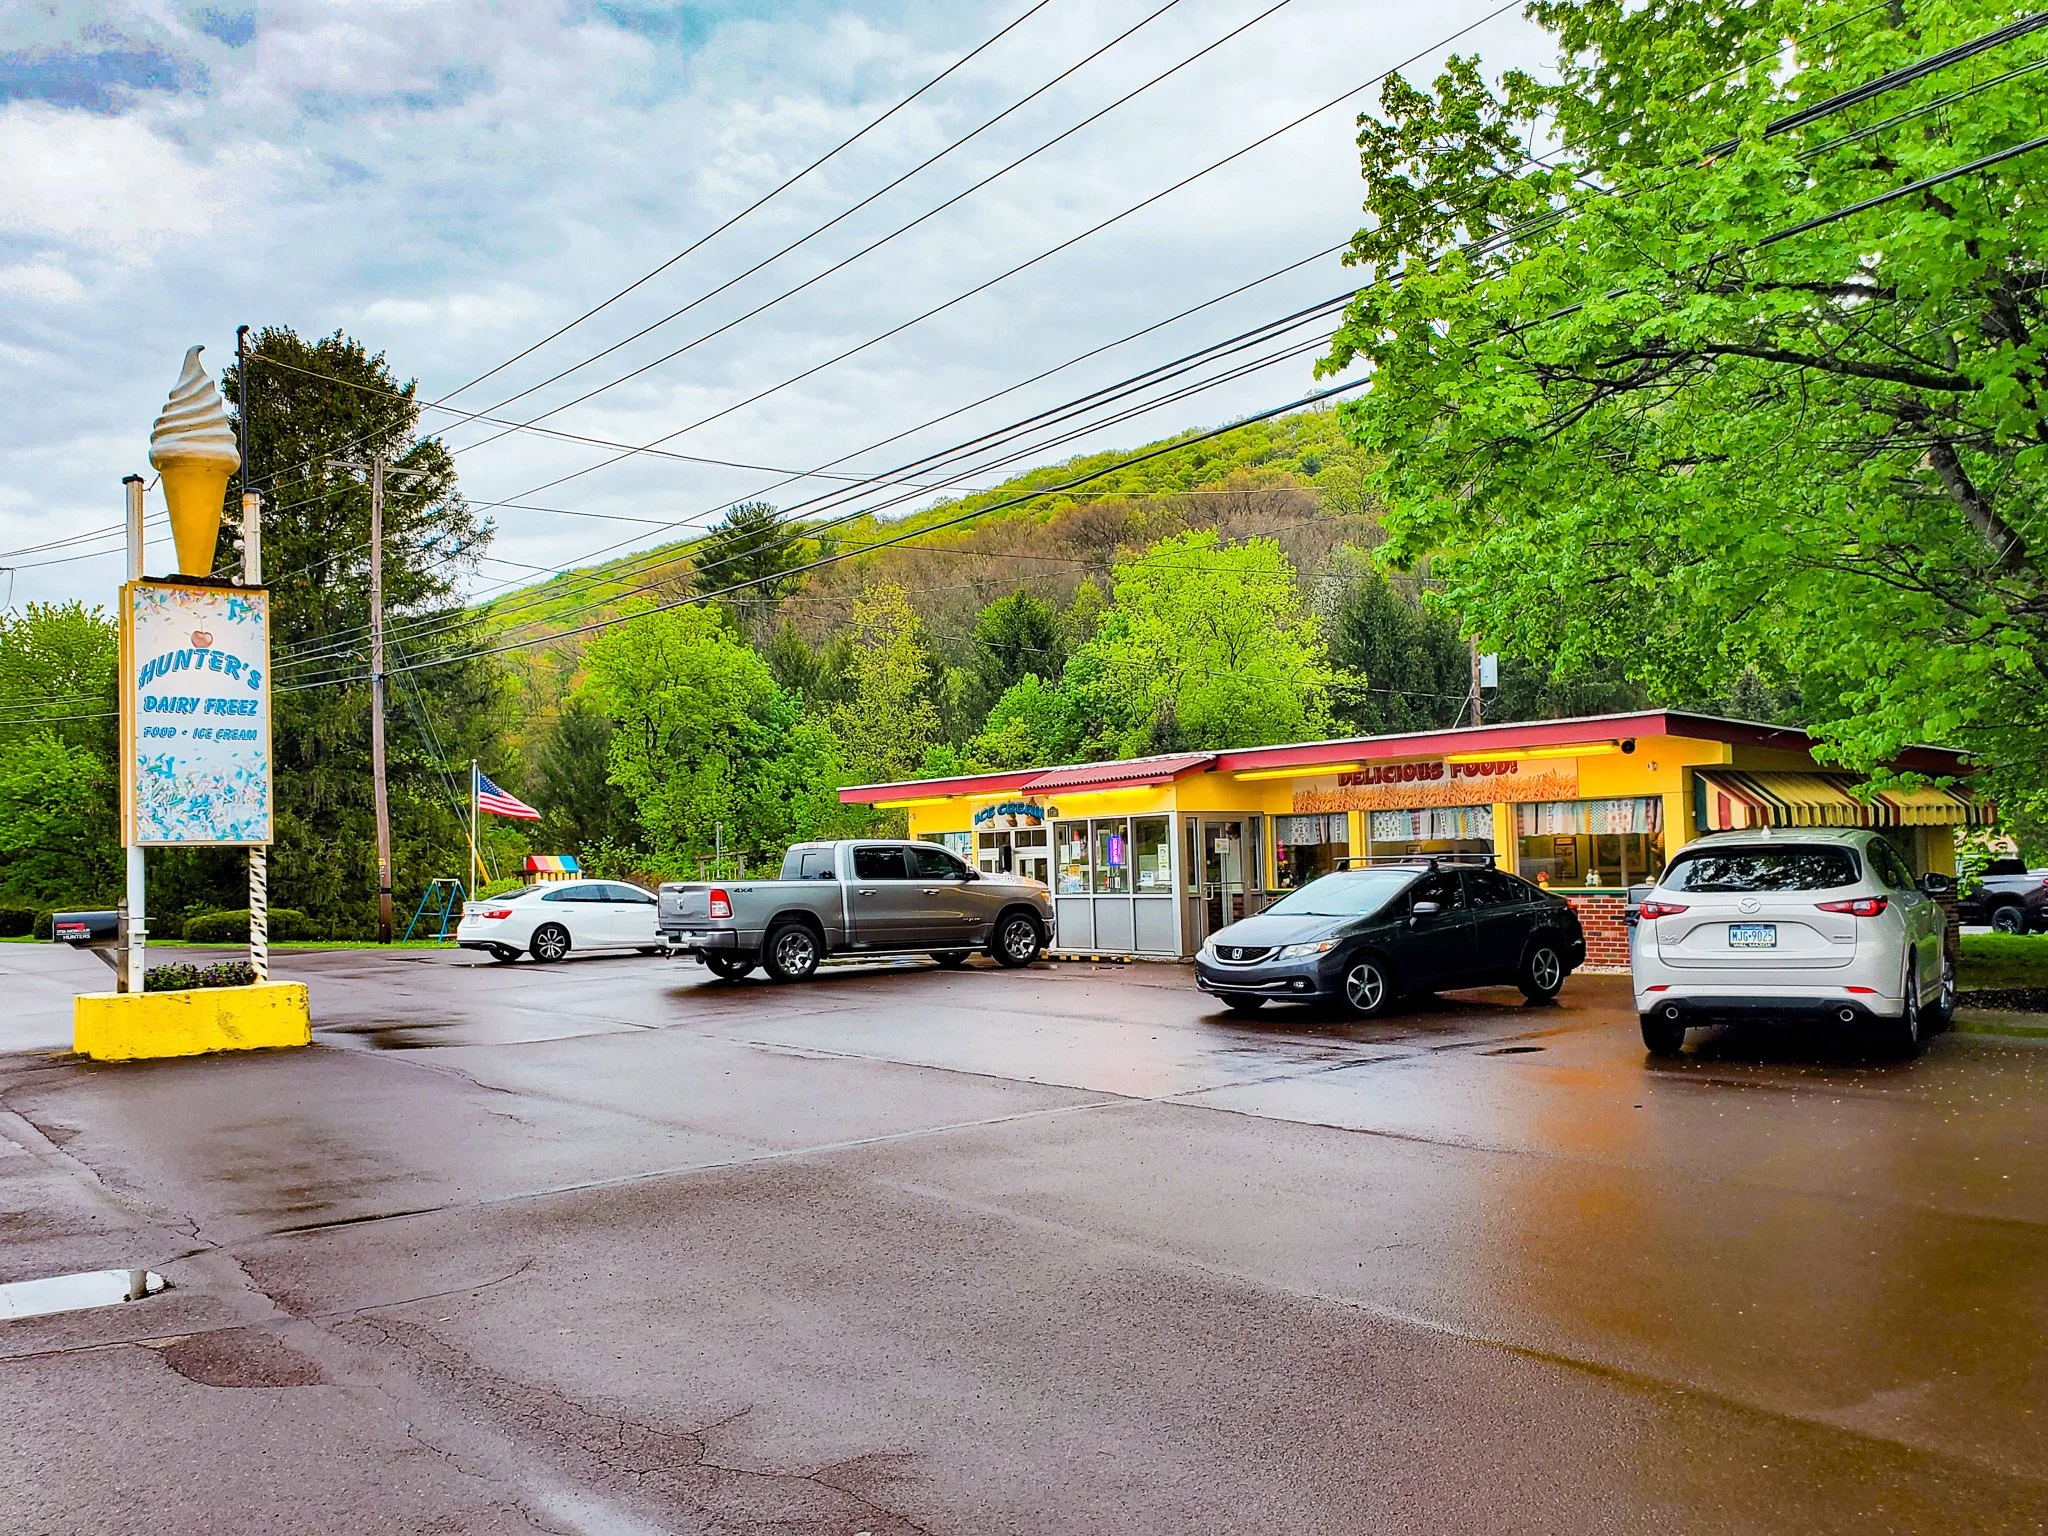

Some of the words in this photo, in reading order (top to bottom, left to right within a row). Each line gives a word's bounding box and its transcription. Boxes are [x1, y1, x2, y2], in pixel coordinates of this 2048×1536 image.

[138, 648, 262, 690] HUNTER'S
[143, 695, 200, 714] DAIRY
[203, 698, 259, 716] FREEZ
[143, 726, 177, 738] FOOD
[192, 727, 213, 739] ICE
[216, 728, 258, 740] CREAM
[1338, 762, 1444, 786] DELICIOUS
[1450, 760, 1518, 779] FOOD!
[974, 805, 995, 826] ICE
